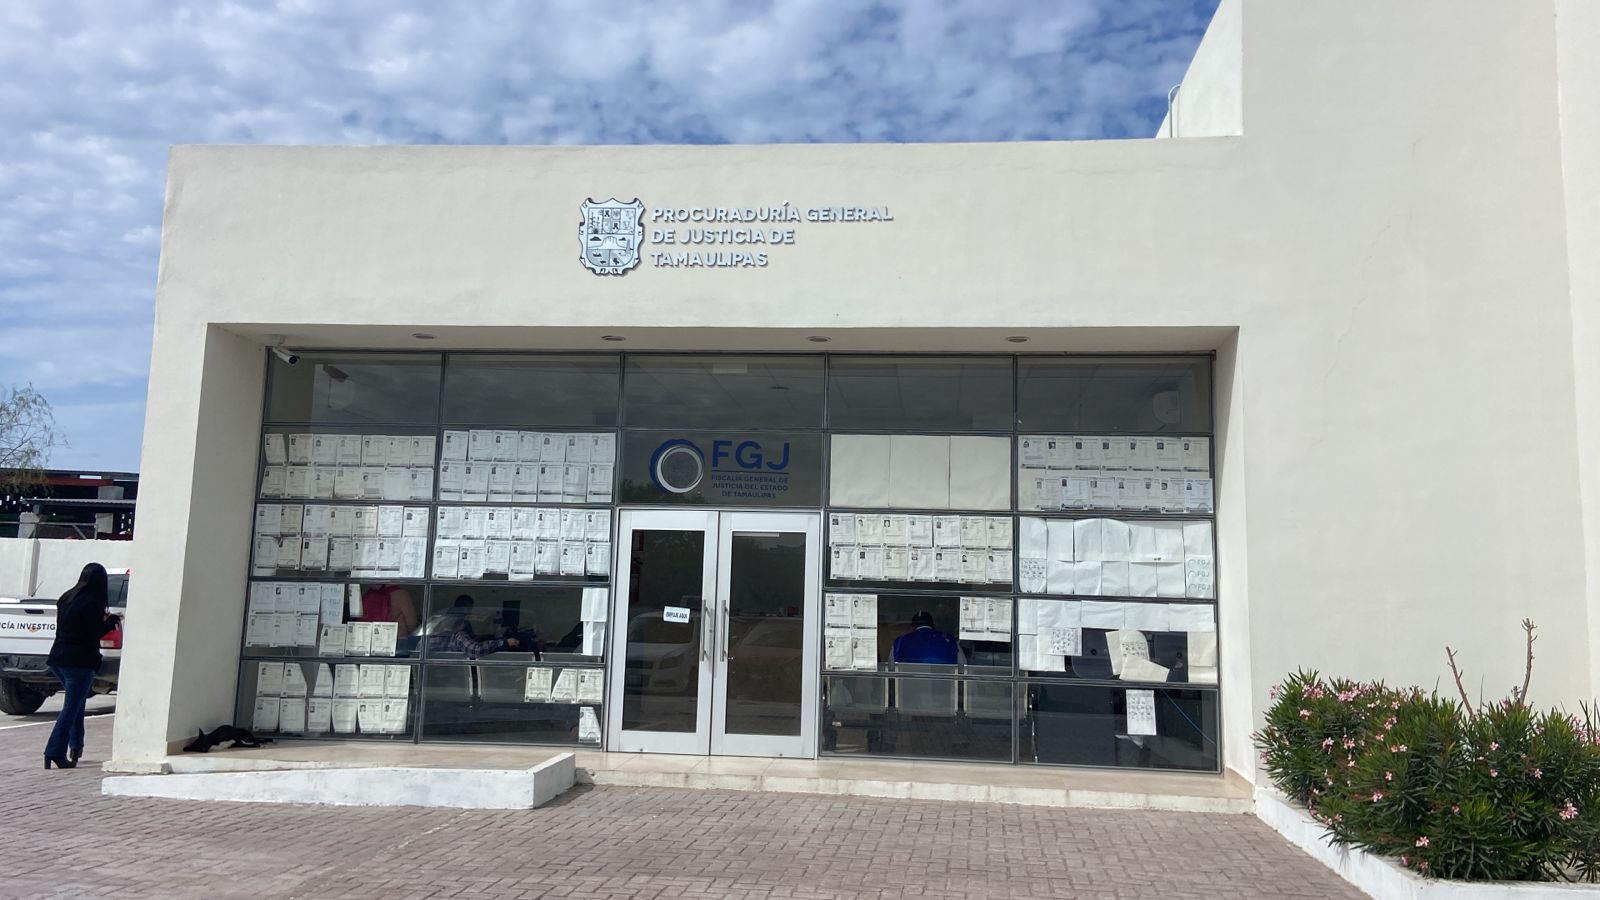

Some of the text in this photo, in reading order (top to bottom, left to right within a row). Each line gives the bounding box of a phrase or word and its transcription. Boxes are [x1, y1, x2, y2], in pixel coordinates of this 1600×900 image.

[652, 200, 894, 222] PROCURADURÍA GENERAL
[651, 228, 796, 244] DE JUSTICIA DE
[651, 251, 769, 267] TAMAULIPAS
[712, 440, 790, 470] FGJ
[744, 475, 776, 483] GENERAL
[734, 490, 777, 498] TAMAULIPAS
[0, 621, 15, 629] CÍA
